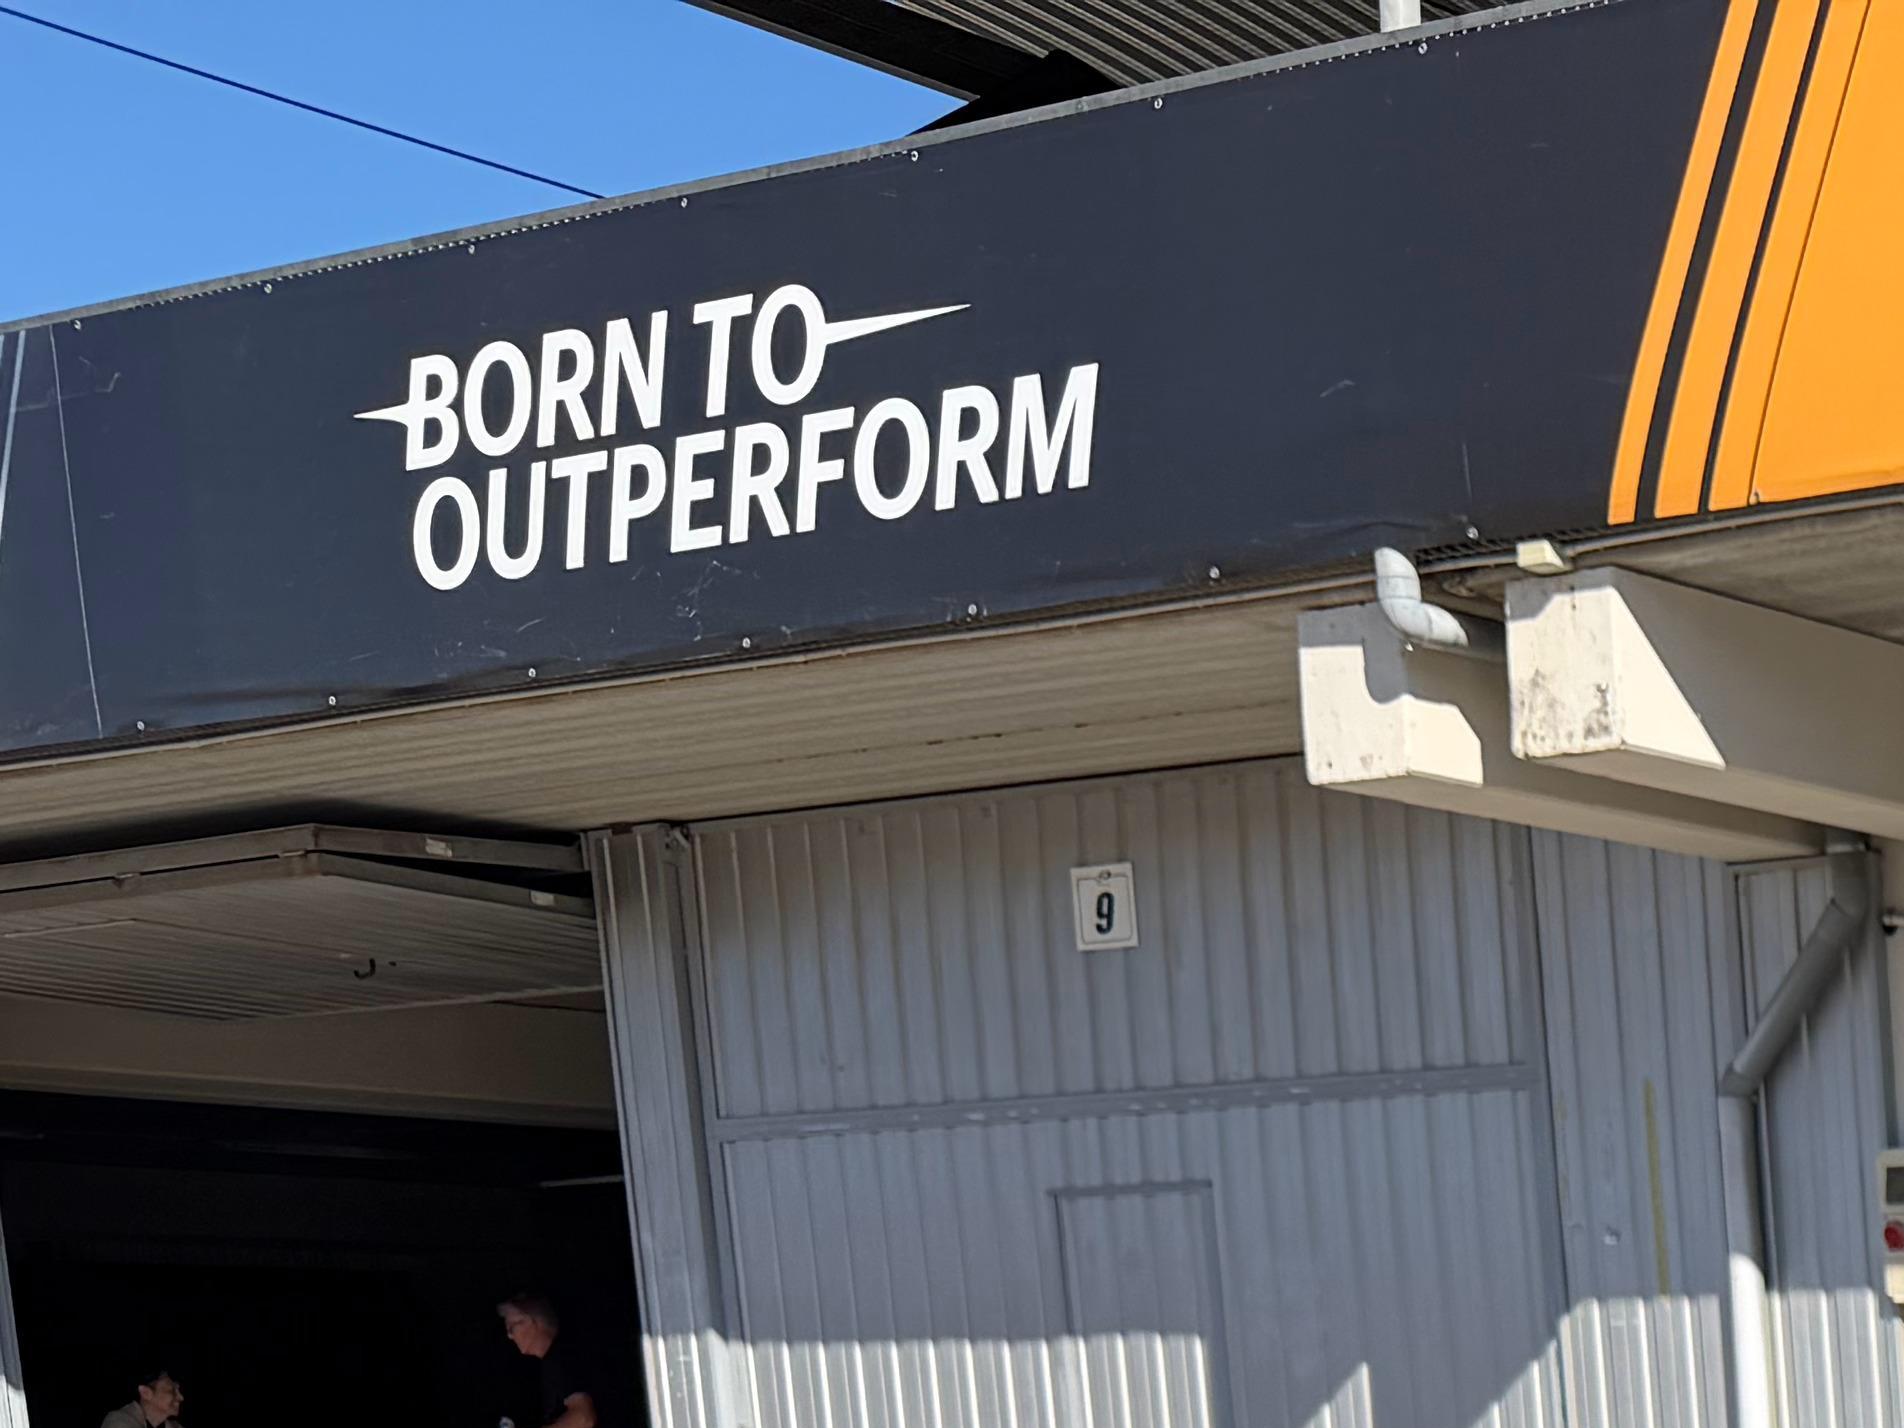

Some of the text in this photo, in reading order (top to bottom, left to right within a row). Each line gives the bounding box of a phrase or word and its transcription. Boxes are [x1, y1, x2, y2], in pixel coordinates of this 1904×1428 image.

[354, 309, 668, 471] BORN
[412, 362, 1100, 591] OUTPERFORM
[1095, 891, 1115, 935] 9
